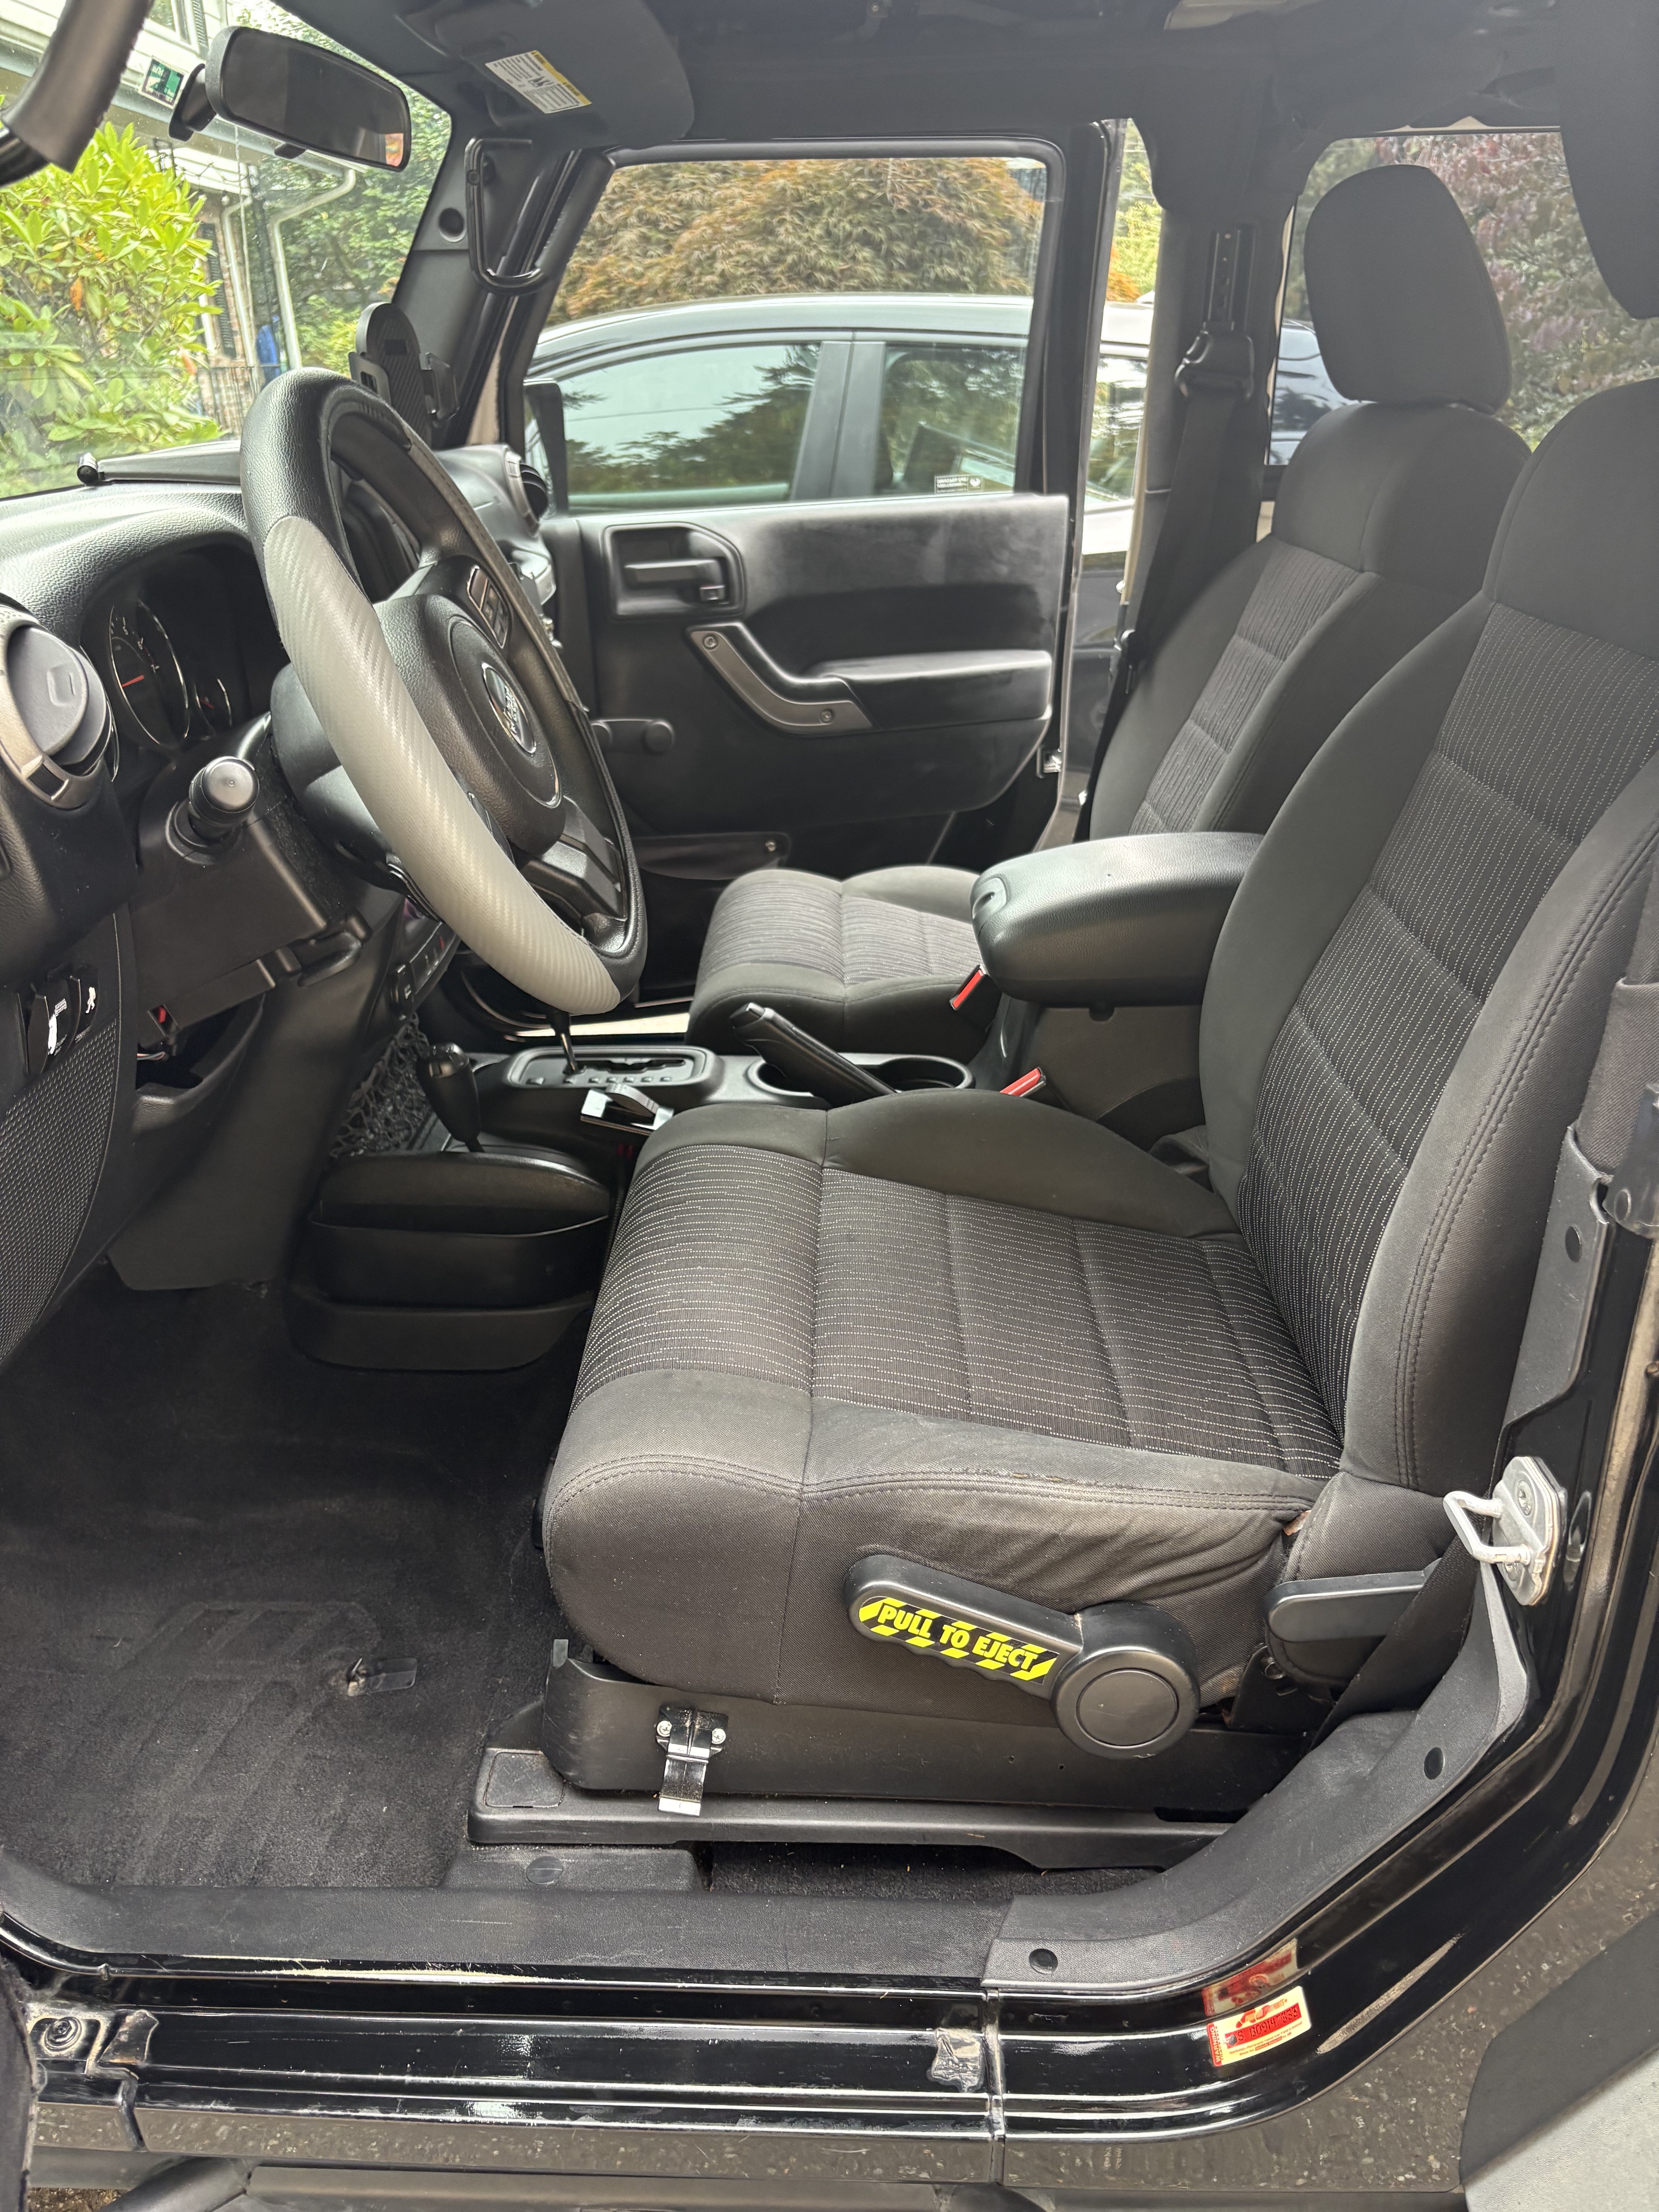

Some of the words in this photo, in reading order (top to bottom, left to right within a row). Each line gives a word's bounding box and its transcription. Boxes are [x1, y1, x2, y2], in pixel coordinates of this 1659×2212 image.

[878, 1605, 932, 1638] PULL
[939, 1624, 970, 1648] TO
[972, 1636, 1038, 1669] EJECT
[1210, 2026, 1221, 2063] WARNING
